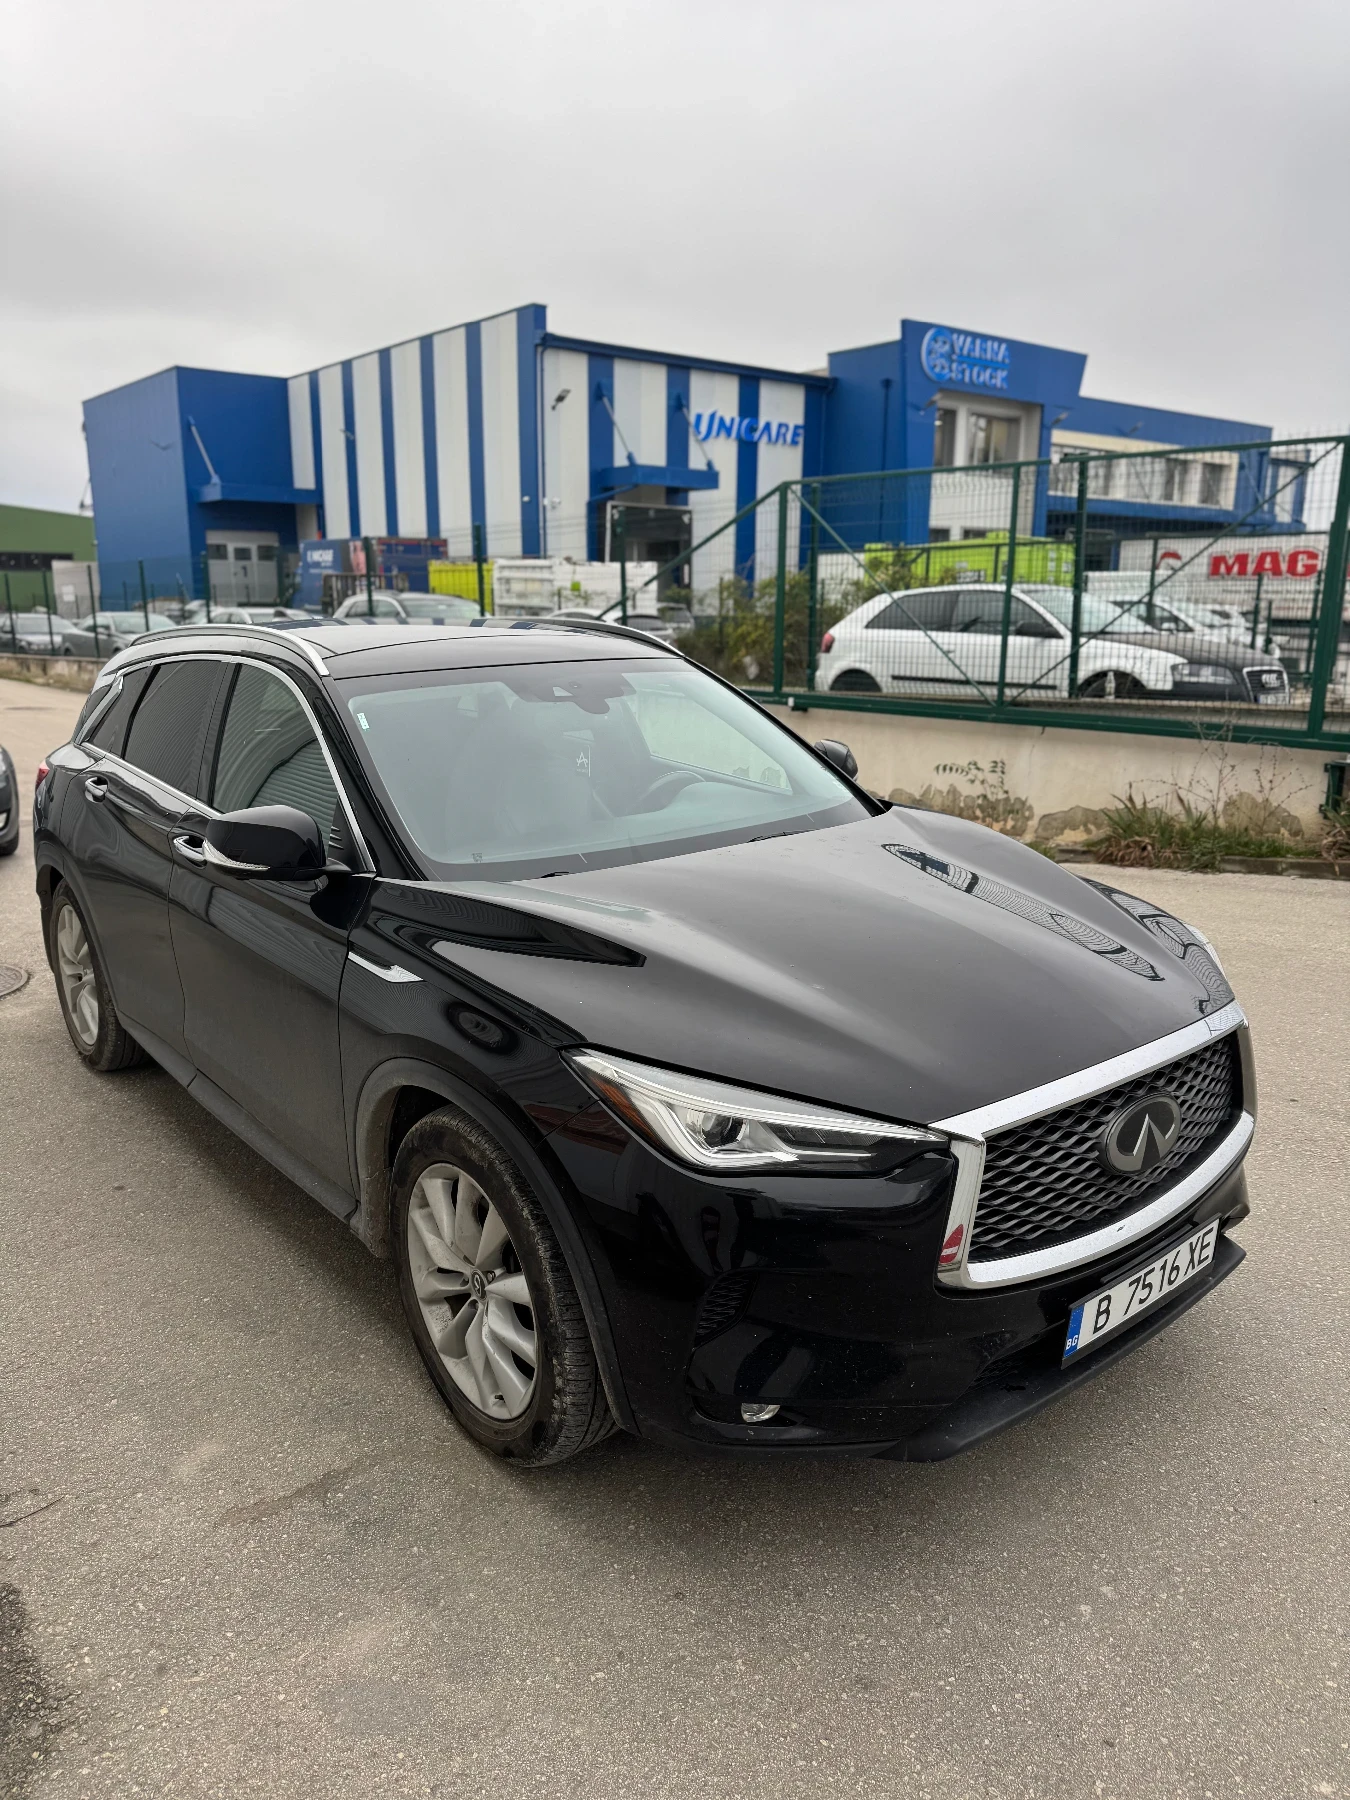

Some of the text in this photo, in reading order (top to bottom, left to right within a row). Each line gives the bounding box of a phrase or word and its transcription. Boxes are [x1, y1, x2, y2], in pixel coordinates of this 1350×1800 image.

[951, 332, 1010, 364] VARNA
[951, 361, 1008, 390] STOCK
[693, 409, 804, 447] UNICARE
[1210, 550, 1319, 577] MAG
[1093, 1227, 1214, 1334] B 7516 XE
[1066, 1335, 1078, 1350] BG
